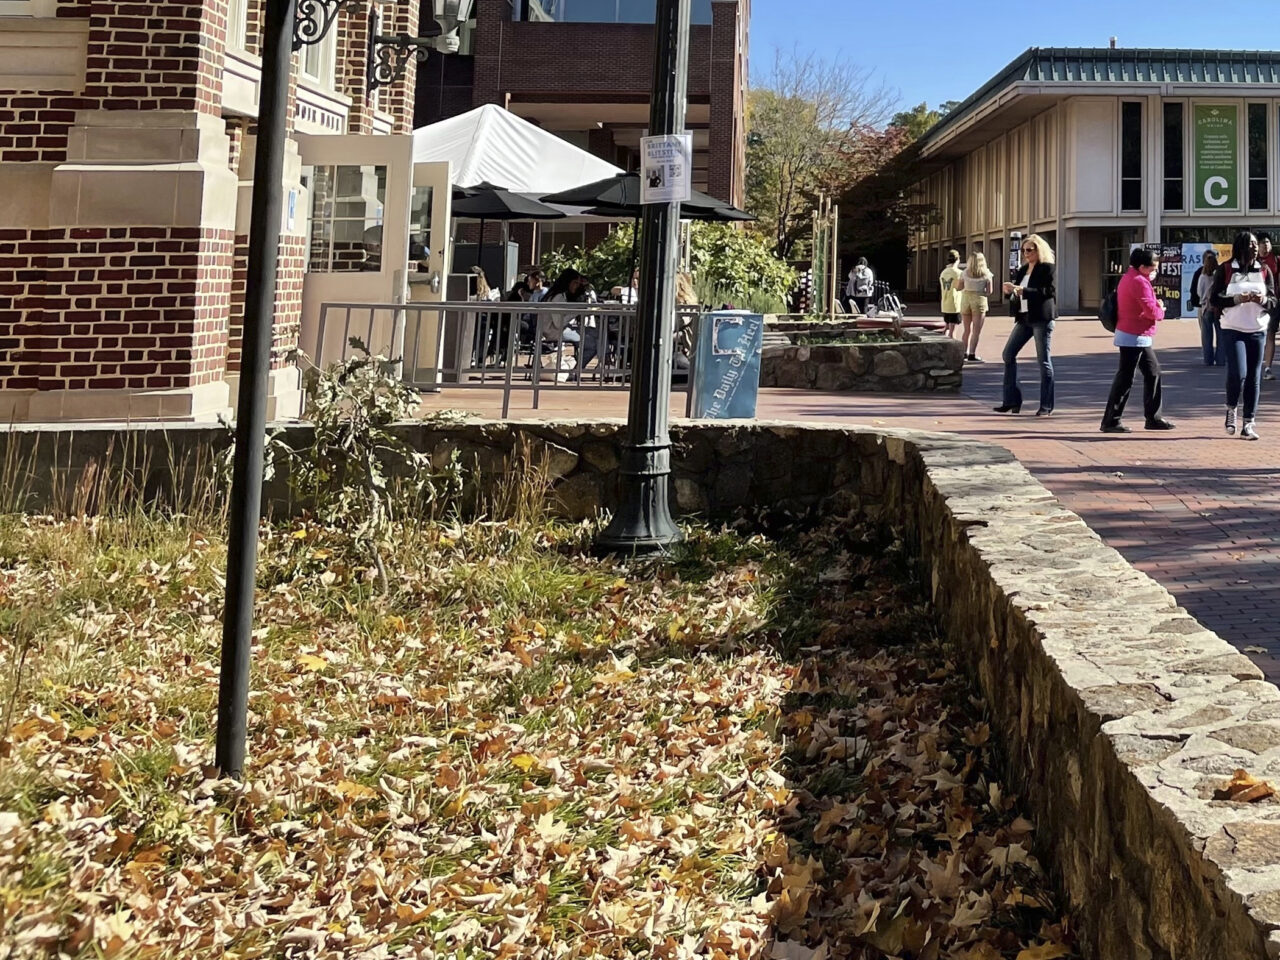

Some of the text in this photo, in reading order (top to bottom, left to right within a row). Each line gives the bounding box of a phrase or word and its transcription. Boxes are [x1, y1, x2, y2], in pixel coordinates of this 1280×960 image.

[1203, 175, 1229, 206] C
[1161, 262, 1182, 276] FEST
[713, 370, 739, 401] Daily
[737, 319, 761, 347] Heel
